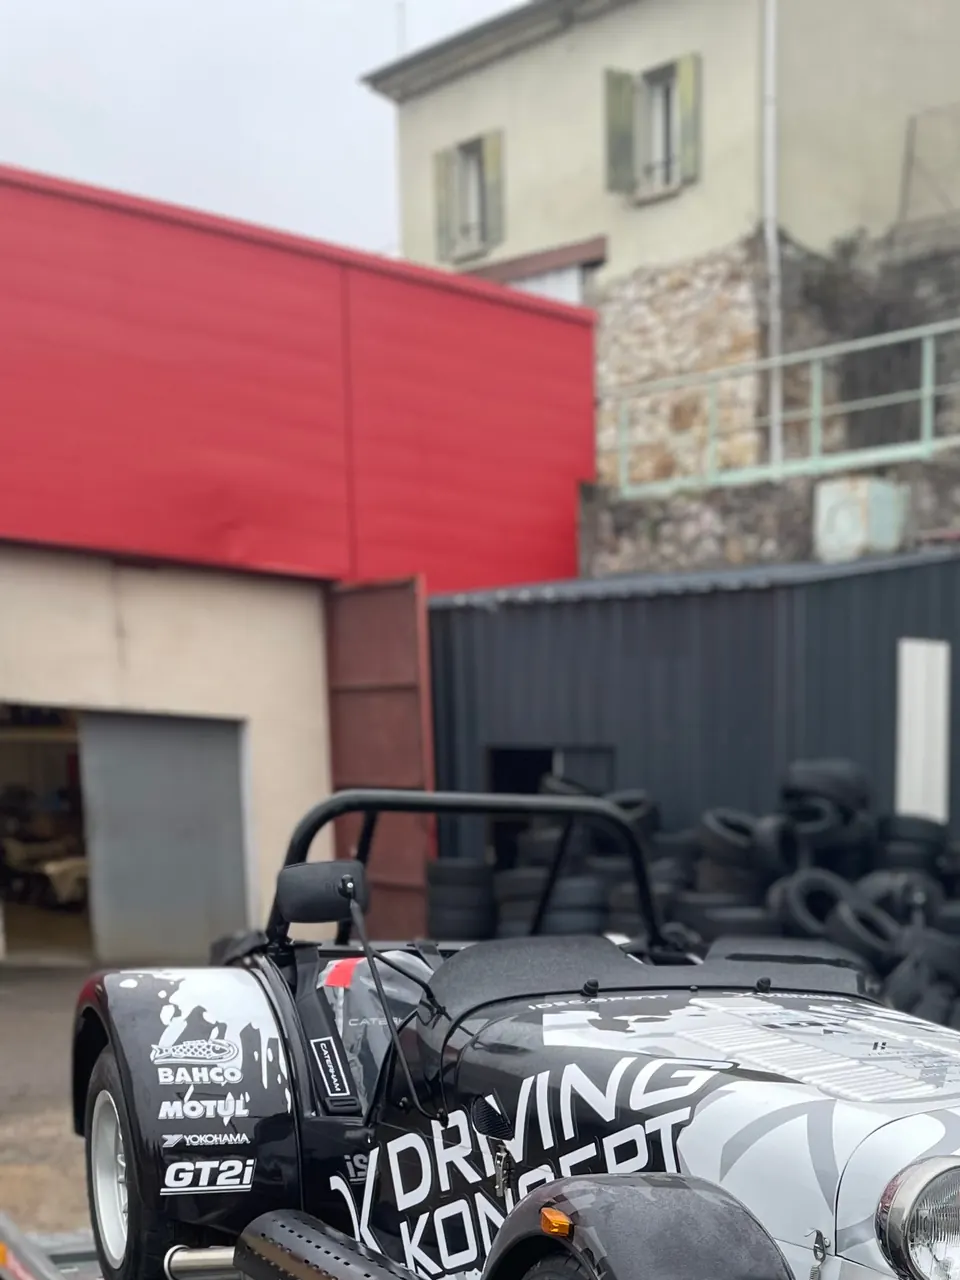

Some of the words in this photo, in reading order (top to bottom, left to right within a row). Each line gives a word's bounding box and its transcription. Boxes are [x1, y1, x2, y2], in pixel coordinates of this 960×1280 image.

[348, 1017, 404, 1027] CATER
[158, 1066, 243, 1086] BAHCO
[320, 1042, 341, 1092] CATERHAM
[158, 1098, 250, 1119] MOTUL
[183, 1133, 251, 1146] YOKOHAMA
[386, 1056, 739, 1212] DRIVING
[164, 1158, 255, 1189] GT2i
